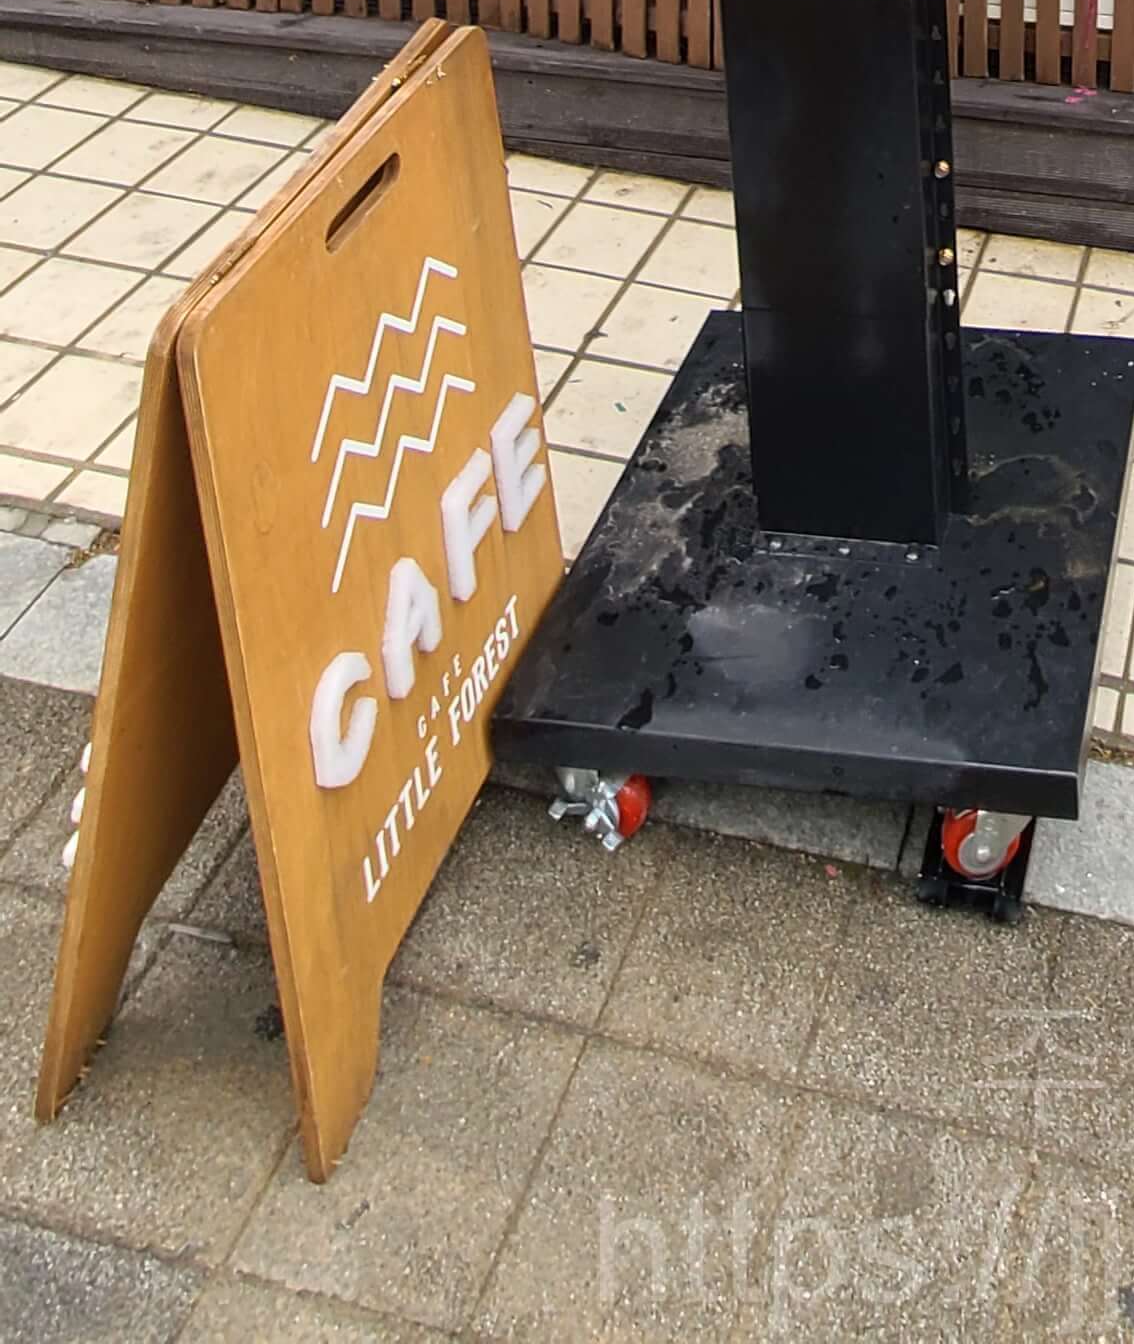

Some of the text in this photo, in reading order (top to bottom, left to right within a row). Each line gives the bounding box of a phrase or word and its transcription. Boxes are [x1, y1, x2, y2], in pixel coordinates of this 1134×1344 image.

[309, 392, 546, 789] CAFE
[417, 652, 463, 740] CAFE
[360, 593, 521, 904] LITTLE FOREST
